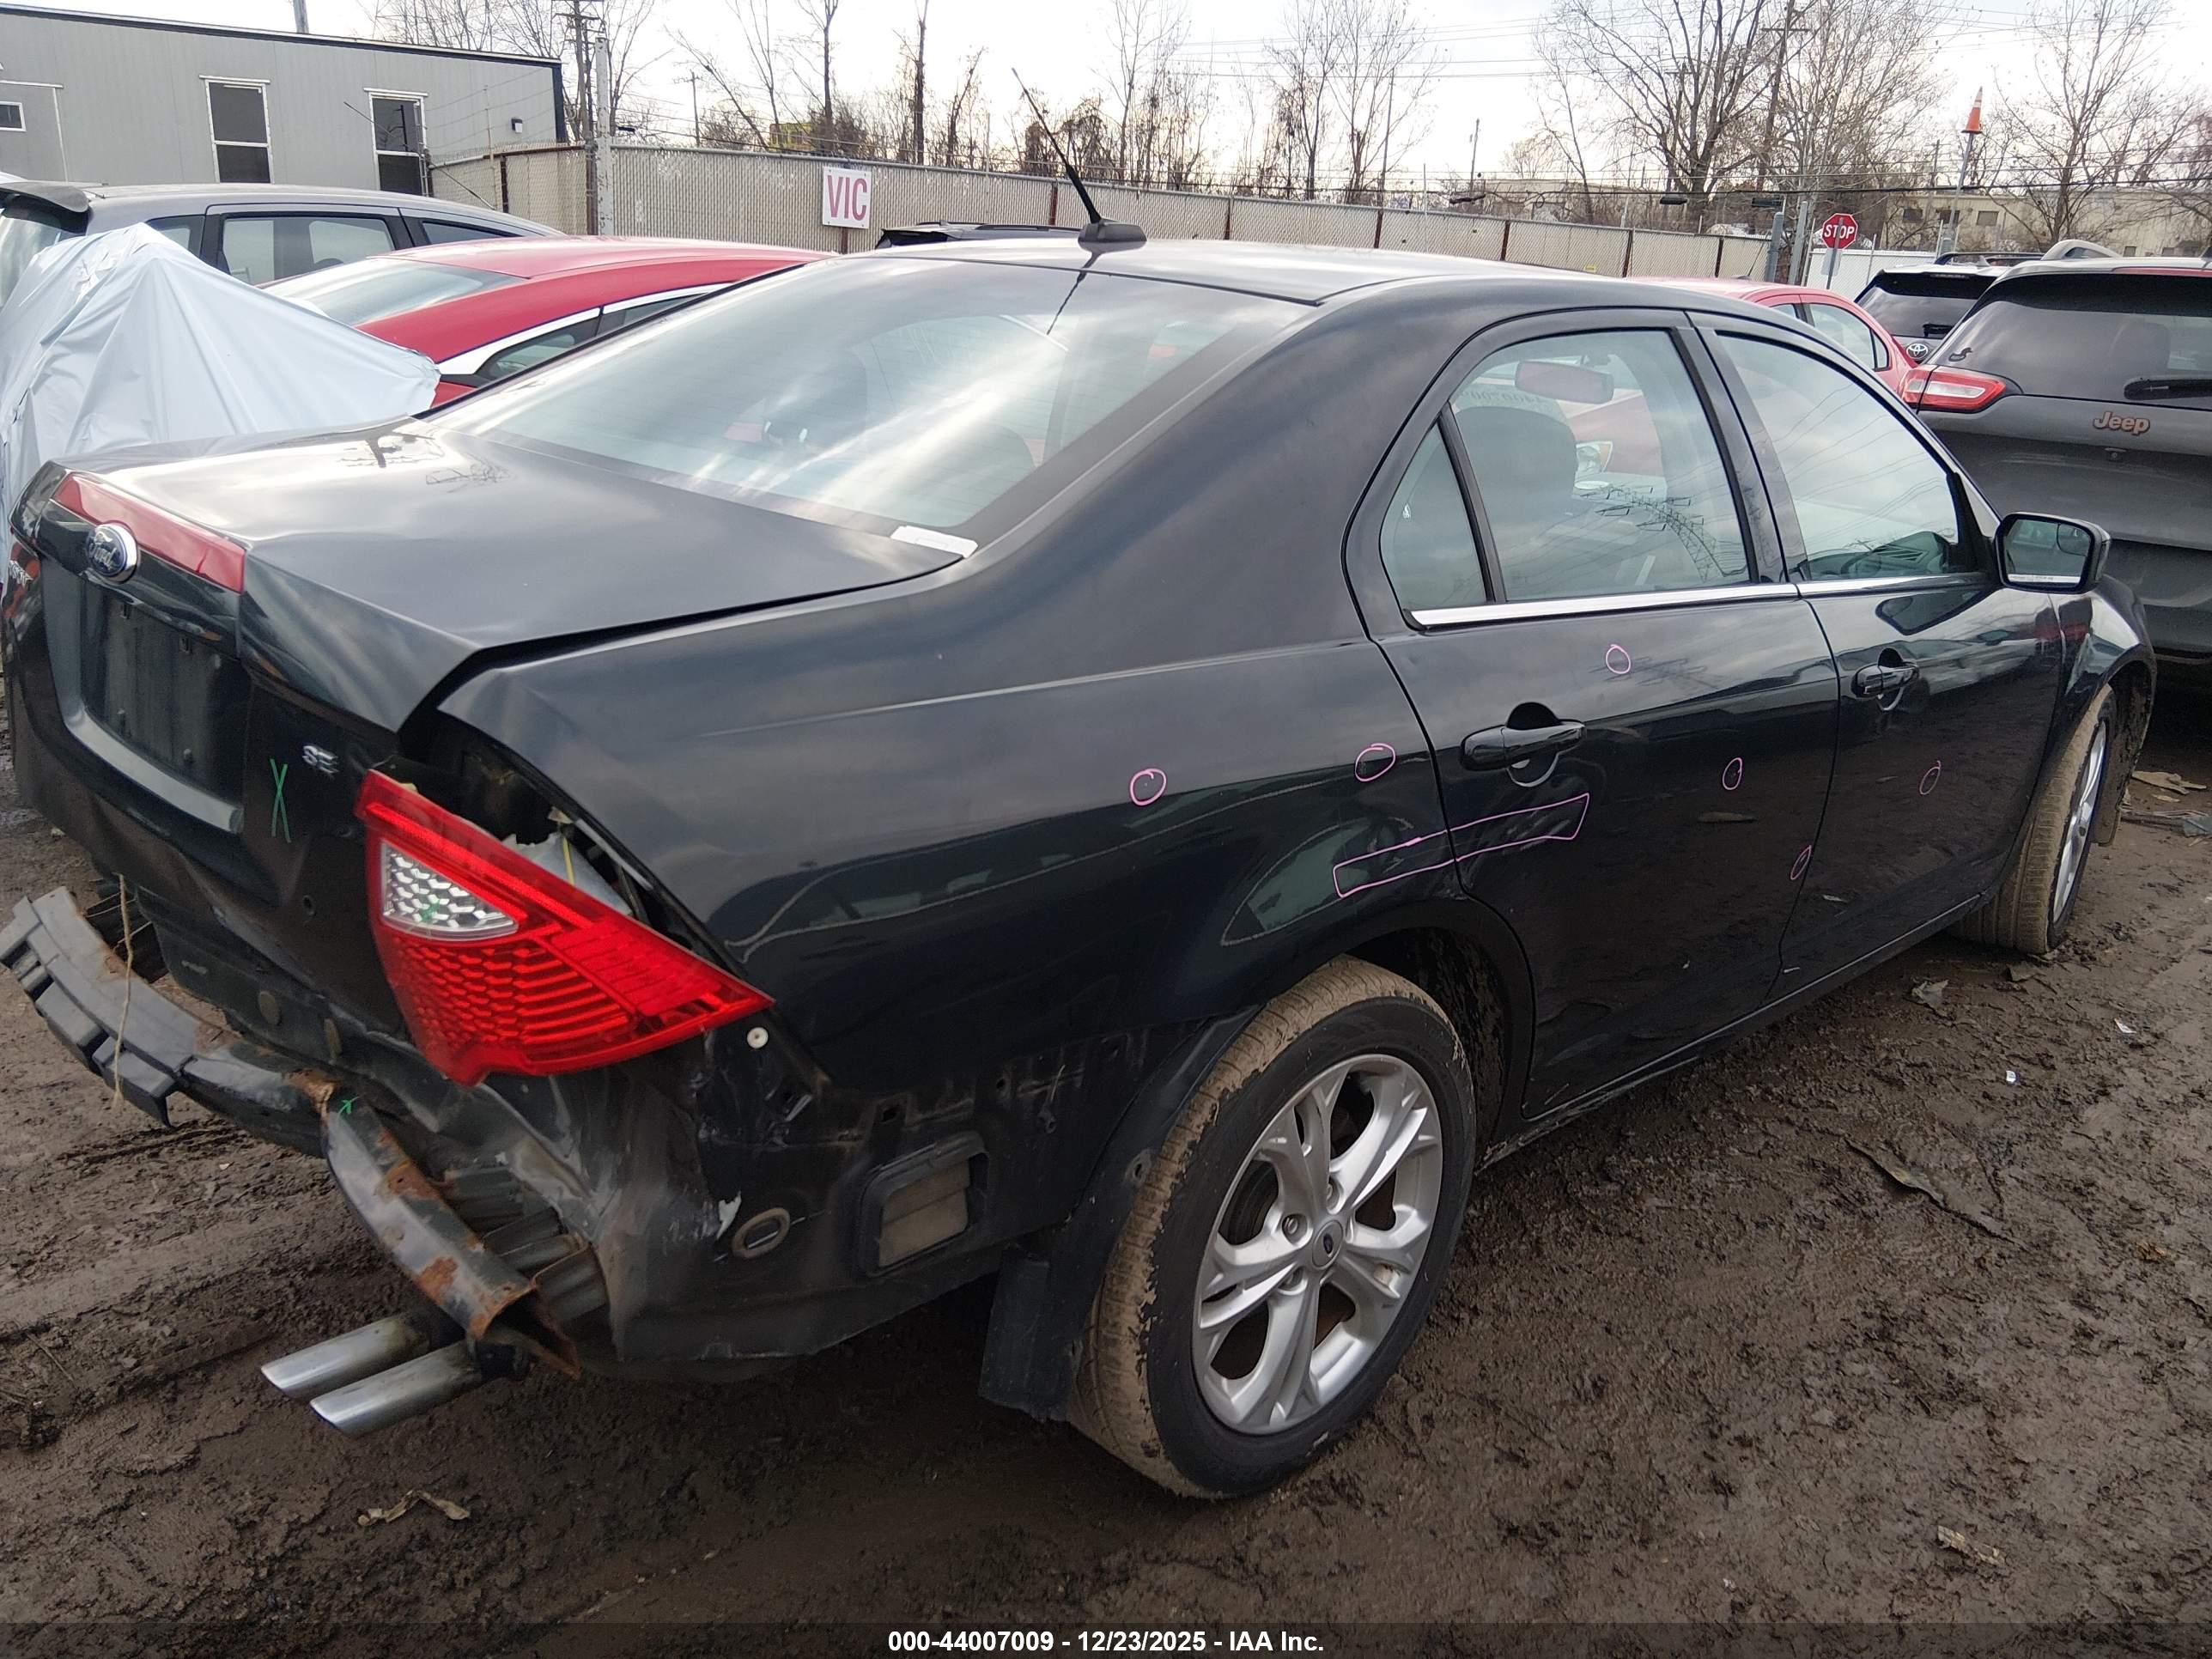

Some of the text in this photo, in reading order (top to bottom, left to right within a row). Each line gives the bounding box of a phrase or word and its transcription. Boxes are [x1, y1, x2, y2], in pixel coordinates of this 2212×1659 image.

[827, 174, 867, 221] VIC
[1823, 223, 1855, 240] STOP
[2093, 411, 2150, 436] Jeep
[302, 744, 339, 775] SE
